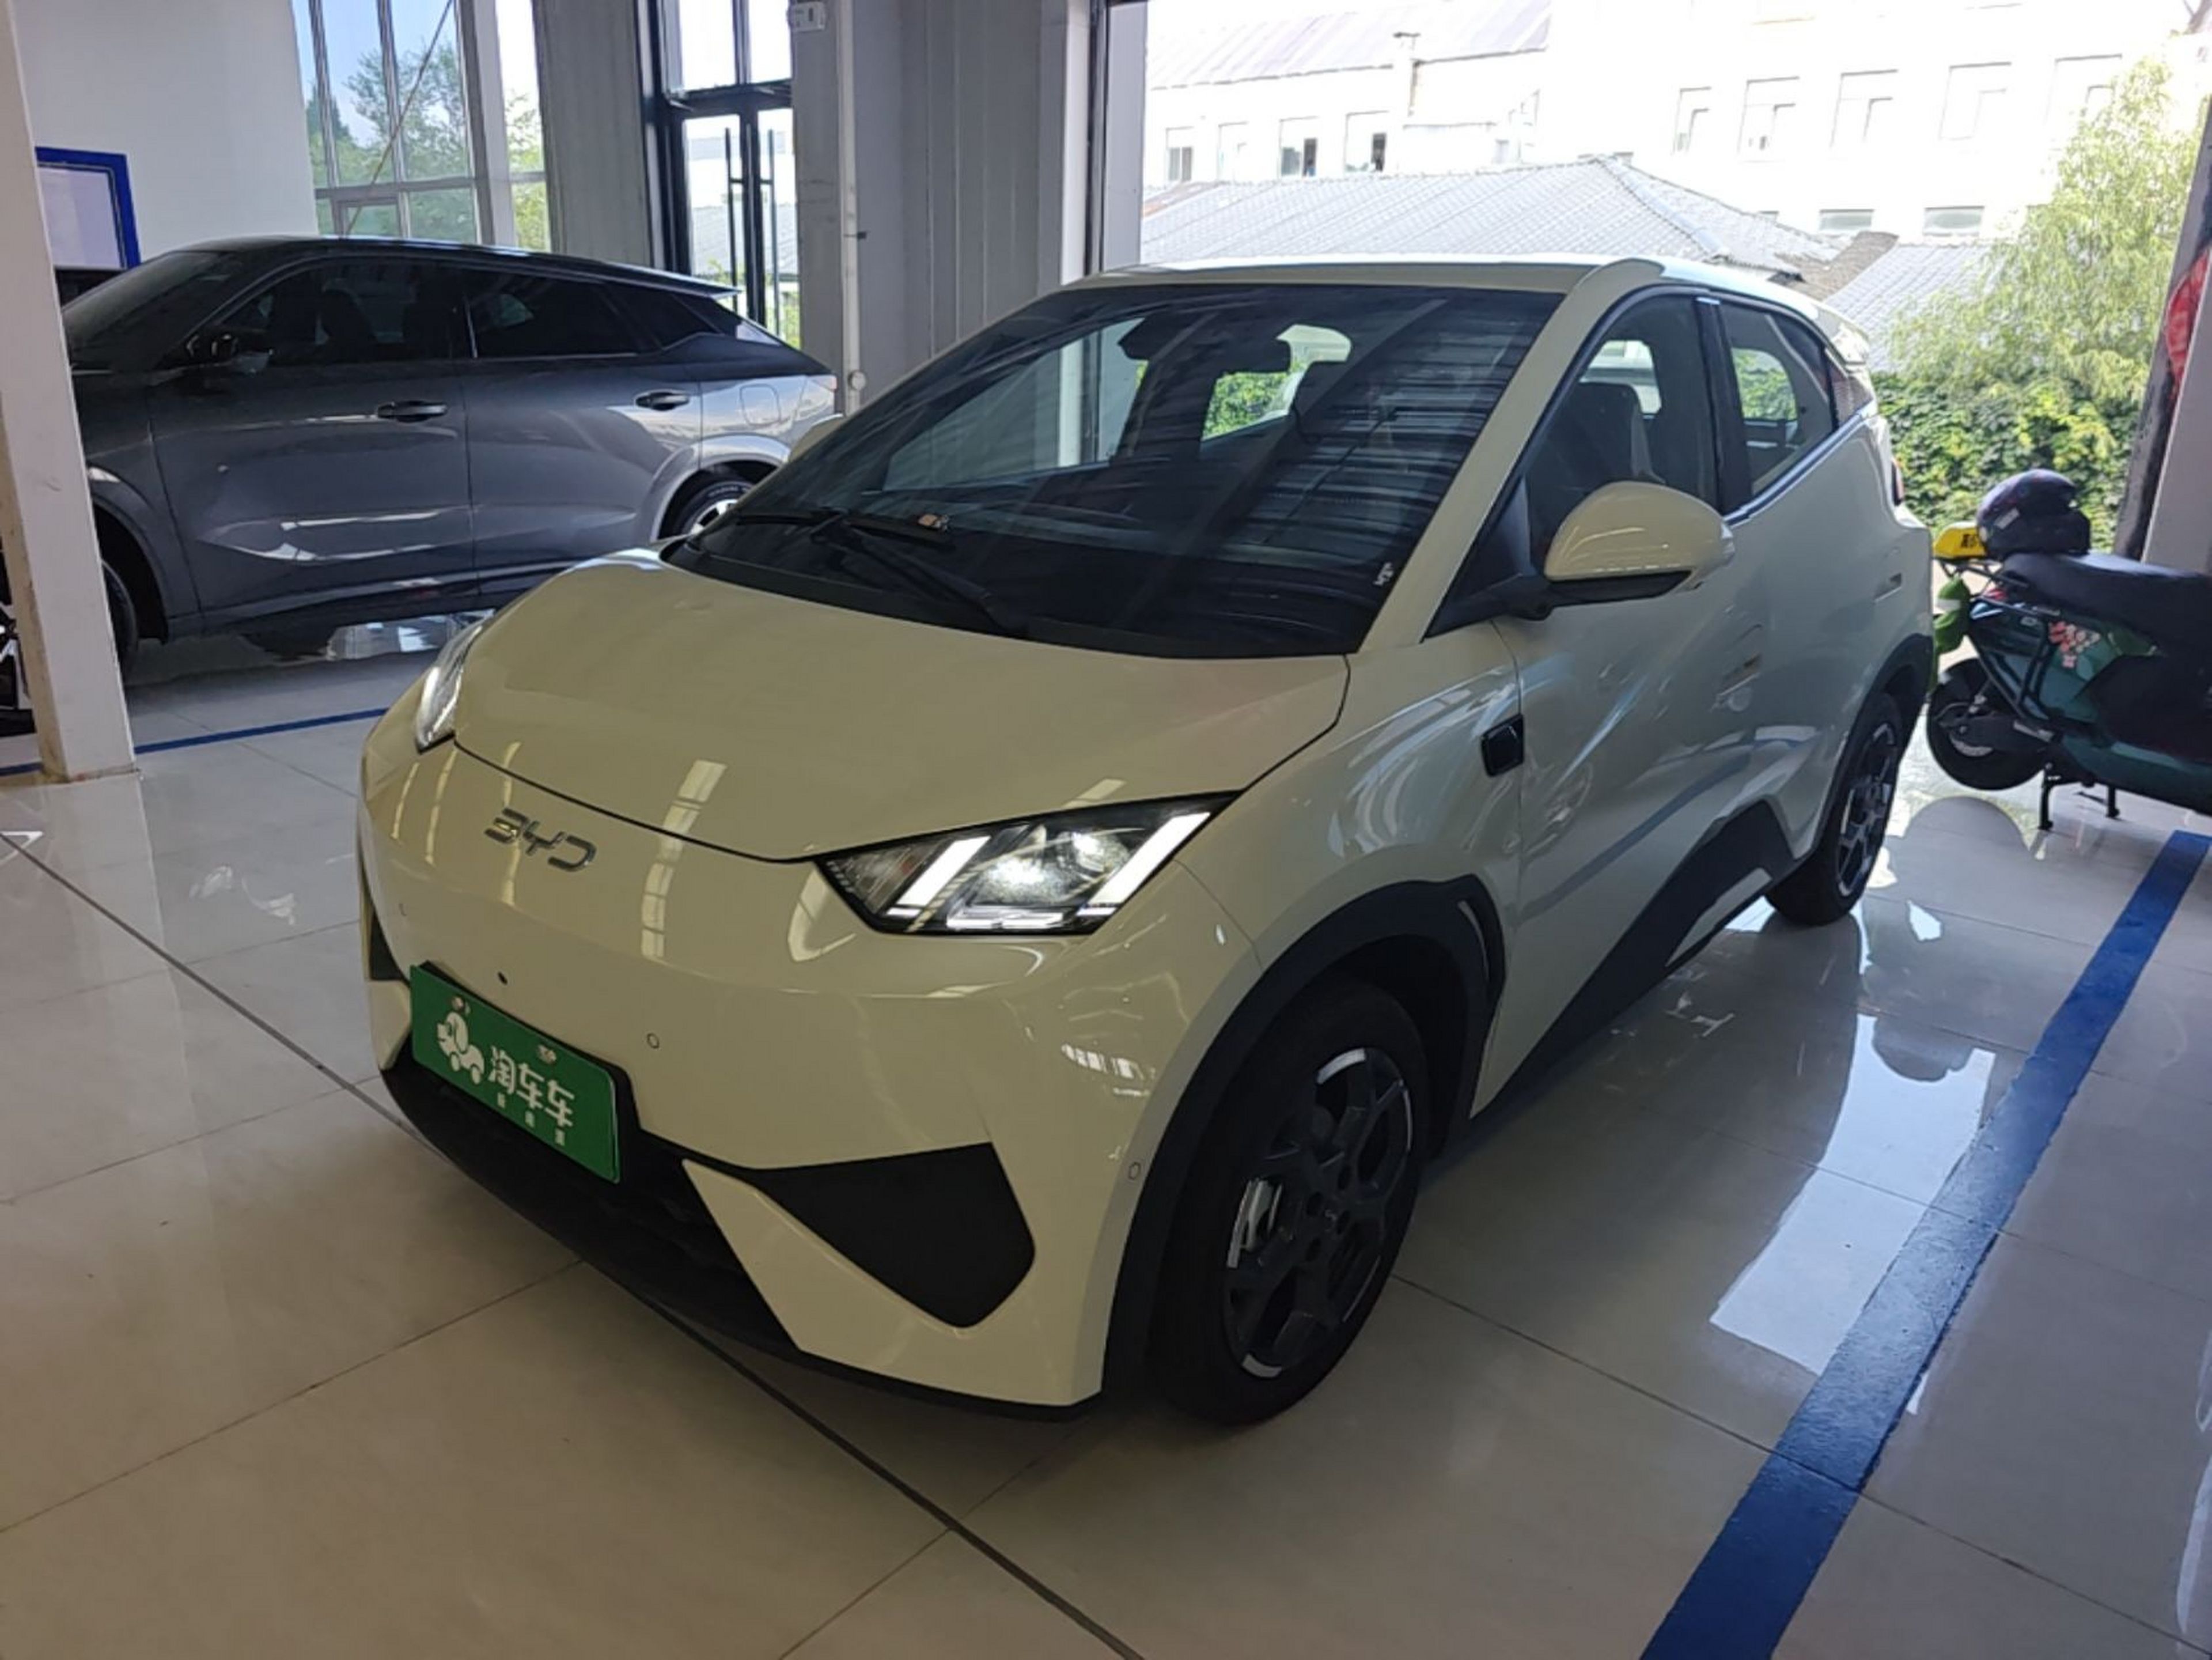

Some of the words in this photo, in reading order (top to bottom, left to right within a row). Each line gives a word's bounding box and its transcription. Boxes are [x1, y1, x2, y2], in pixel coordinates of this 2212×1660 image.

[483, 807, 597, 872] BYD
[488, 1045, 575, 1128] 淘车车
